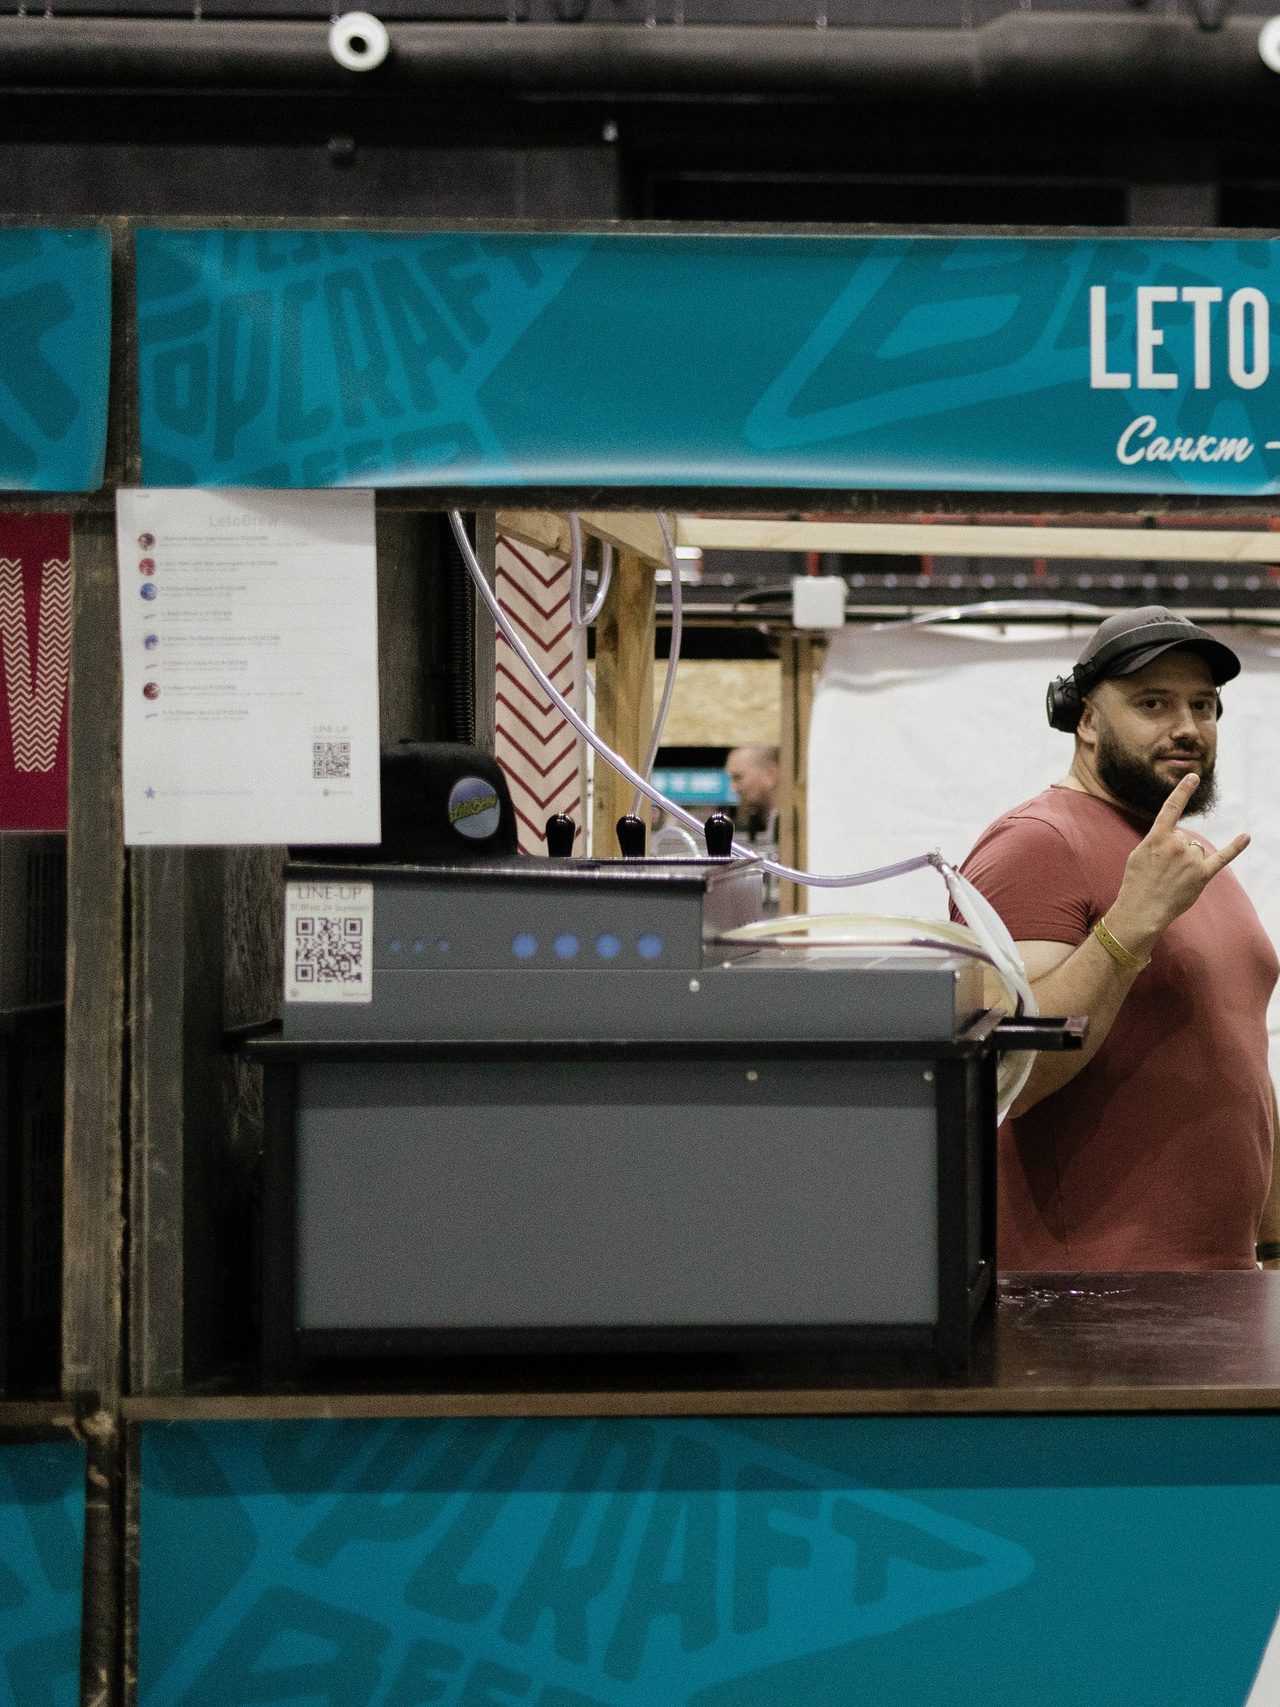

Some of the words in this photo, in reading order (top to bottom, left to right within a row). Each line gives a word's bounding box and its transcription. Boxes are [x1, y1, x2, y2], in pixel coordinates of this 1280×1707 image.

[1089, 285, 1271, 390] LETO
[1116, 414, 1255, 465] Санкт
[298, 886, 362, 899] LINE-UP
